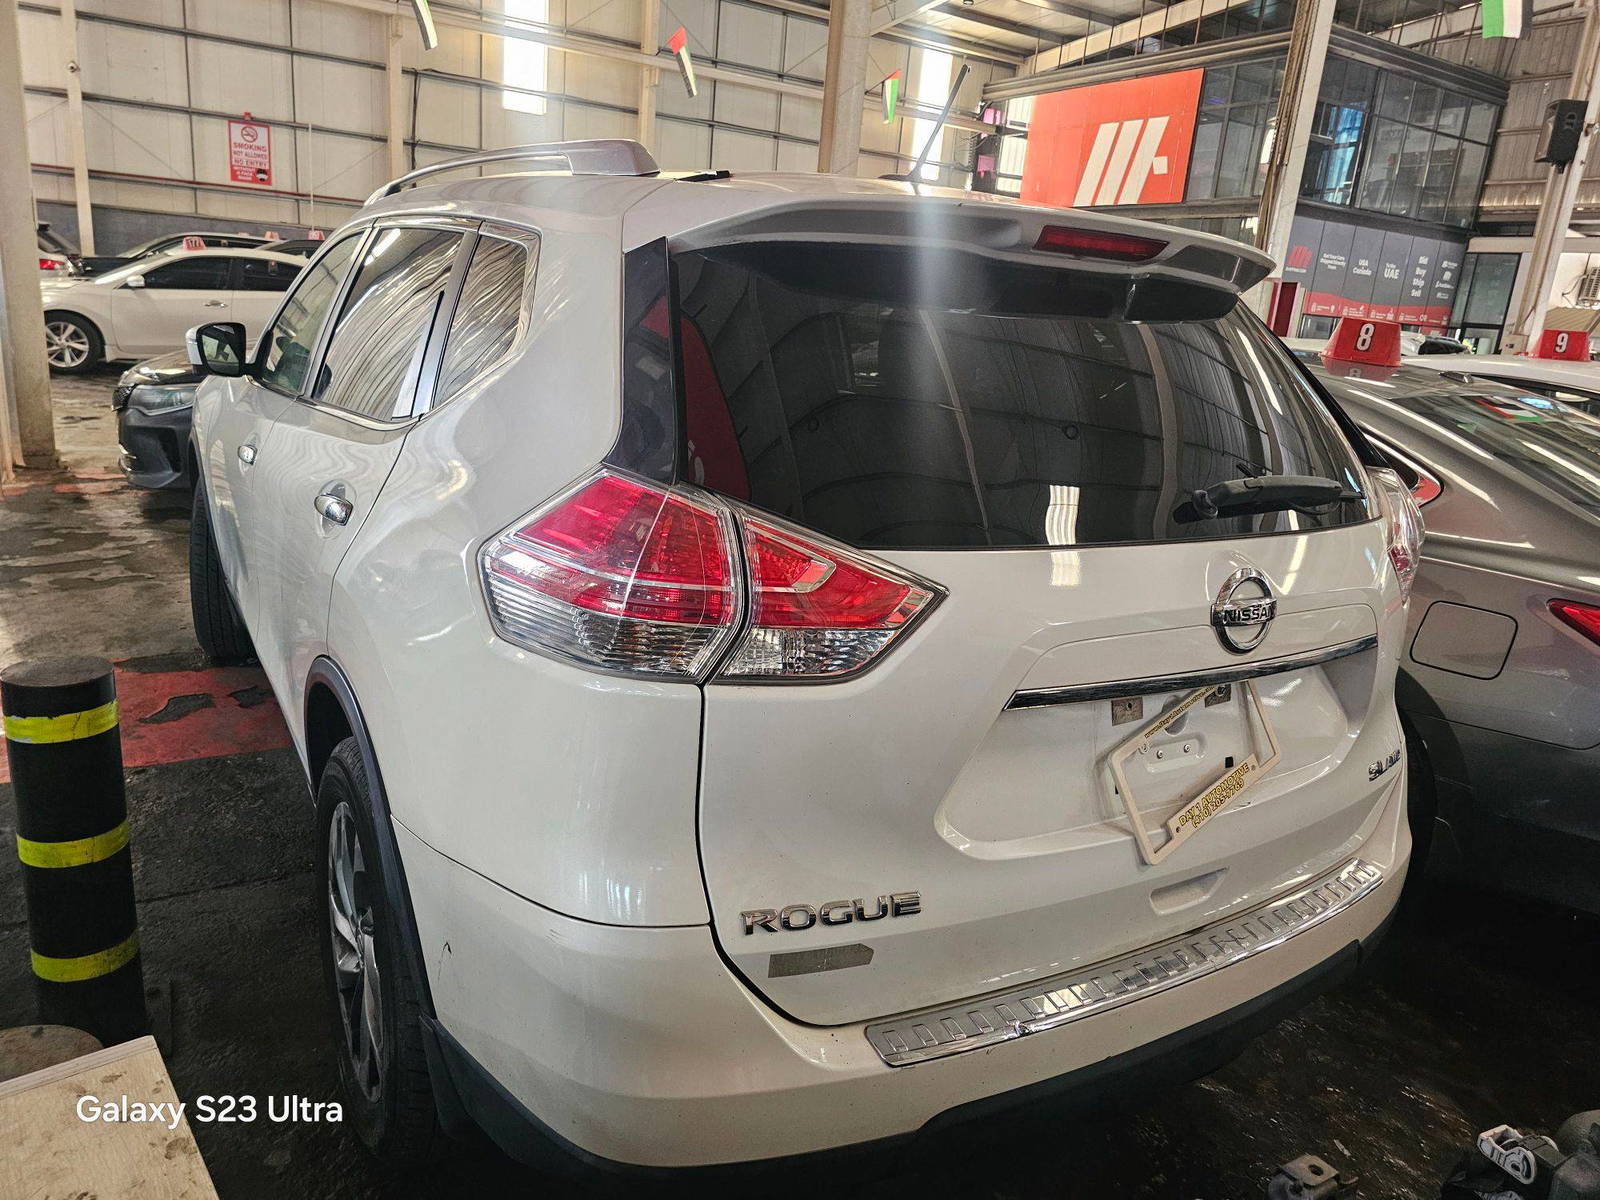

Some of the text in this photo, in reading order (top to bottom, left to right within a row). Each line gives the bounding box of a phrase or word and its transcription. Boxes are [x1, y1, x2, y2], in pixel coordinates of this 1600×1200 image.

[233, 142, 267, 153] SMOKING
[244, 151, 267, 160] ALLOWED
[1352, 266, 1372, 276] Canada
[1384, 267, 1400, 279] UAE
[1415, 266, 1427, 278] Buy
[1412, 278, 1425, 288] Ship
[1411, 288, 1422, 297] Sell
[1356, 323, 1375, 351] 8
[1555, 332, 1569, 353] 9
[1178, 806, 1197, 827] DAY
[1201, 762, 1250, 809] AUTOMOTIVE
[739, 889, 922, 936] ROGUE
